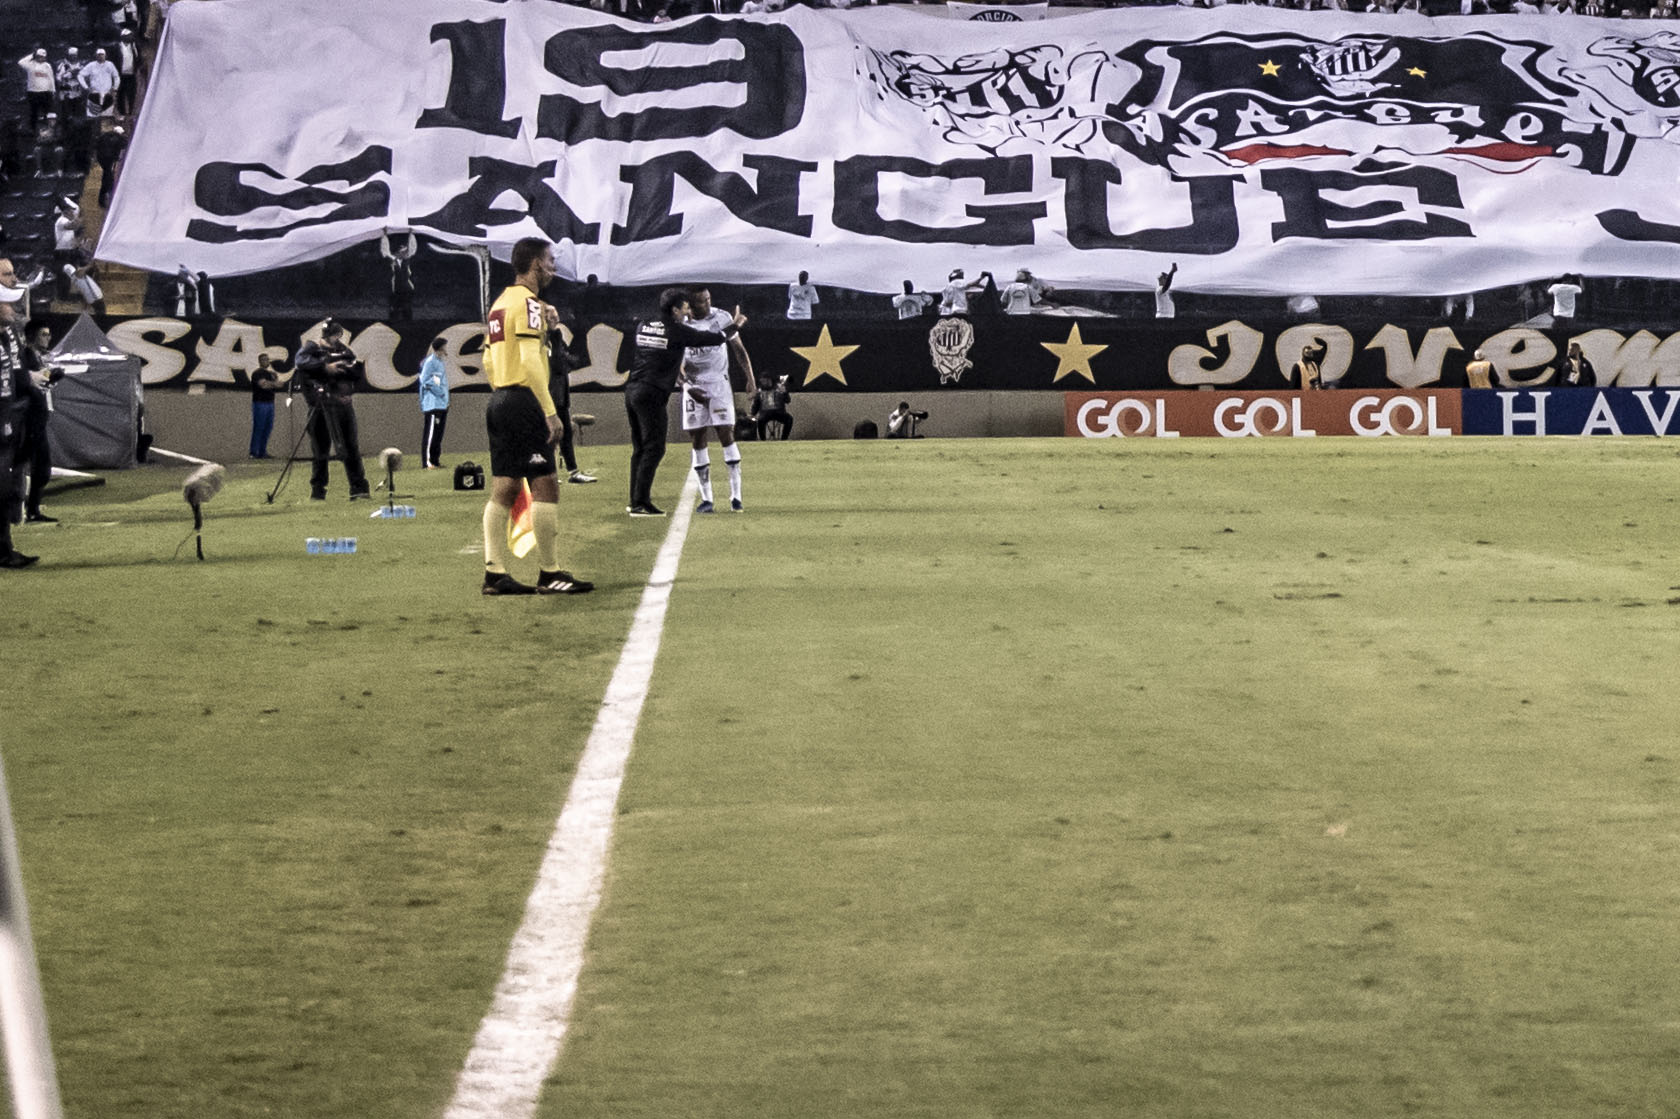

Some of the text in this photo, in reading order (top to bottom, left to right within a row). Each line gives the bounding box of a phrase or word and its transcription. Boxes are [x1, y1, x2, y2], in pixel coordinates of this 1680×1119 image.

[416, 15, 806, 146] 19
[186, 145, 1477, 254] SANGUE
[1076, 398, 1181, 438] GOL
[1213, 397, 1316, 437] GOL
[1349, 396, 1452, 436] GOL
